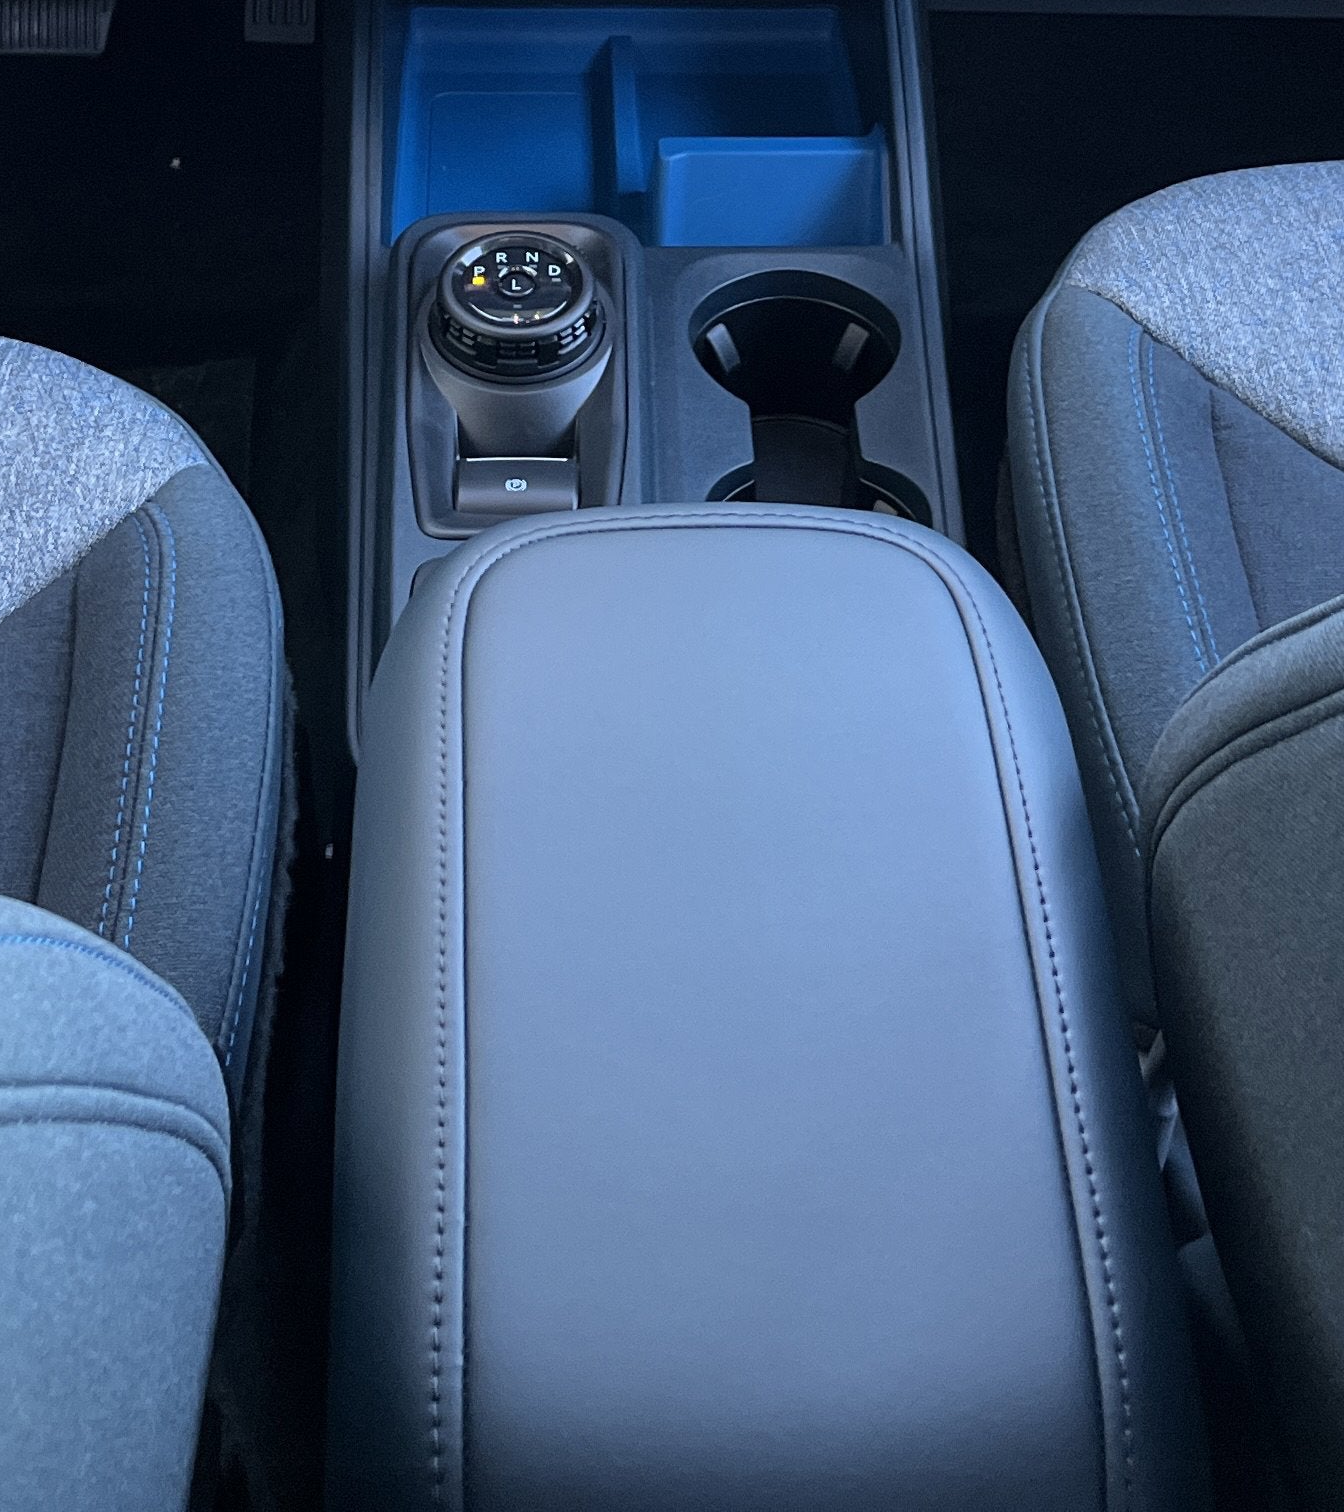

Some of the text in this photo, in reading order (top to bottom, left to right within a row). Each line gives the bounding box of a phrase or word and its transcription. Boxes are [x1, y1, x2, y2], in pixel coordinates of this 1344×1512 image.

[495, 252, 508, 263] R
[525, 251, 539, 263] N
[473, 265, 486, 277] P
[548, 264, 561, 276] D
[511, 278, 522, 290] L
